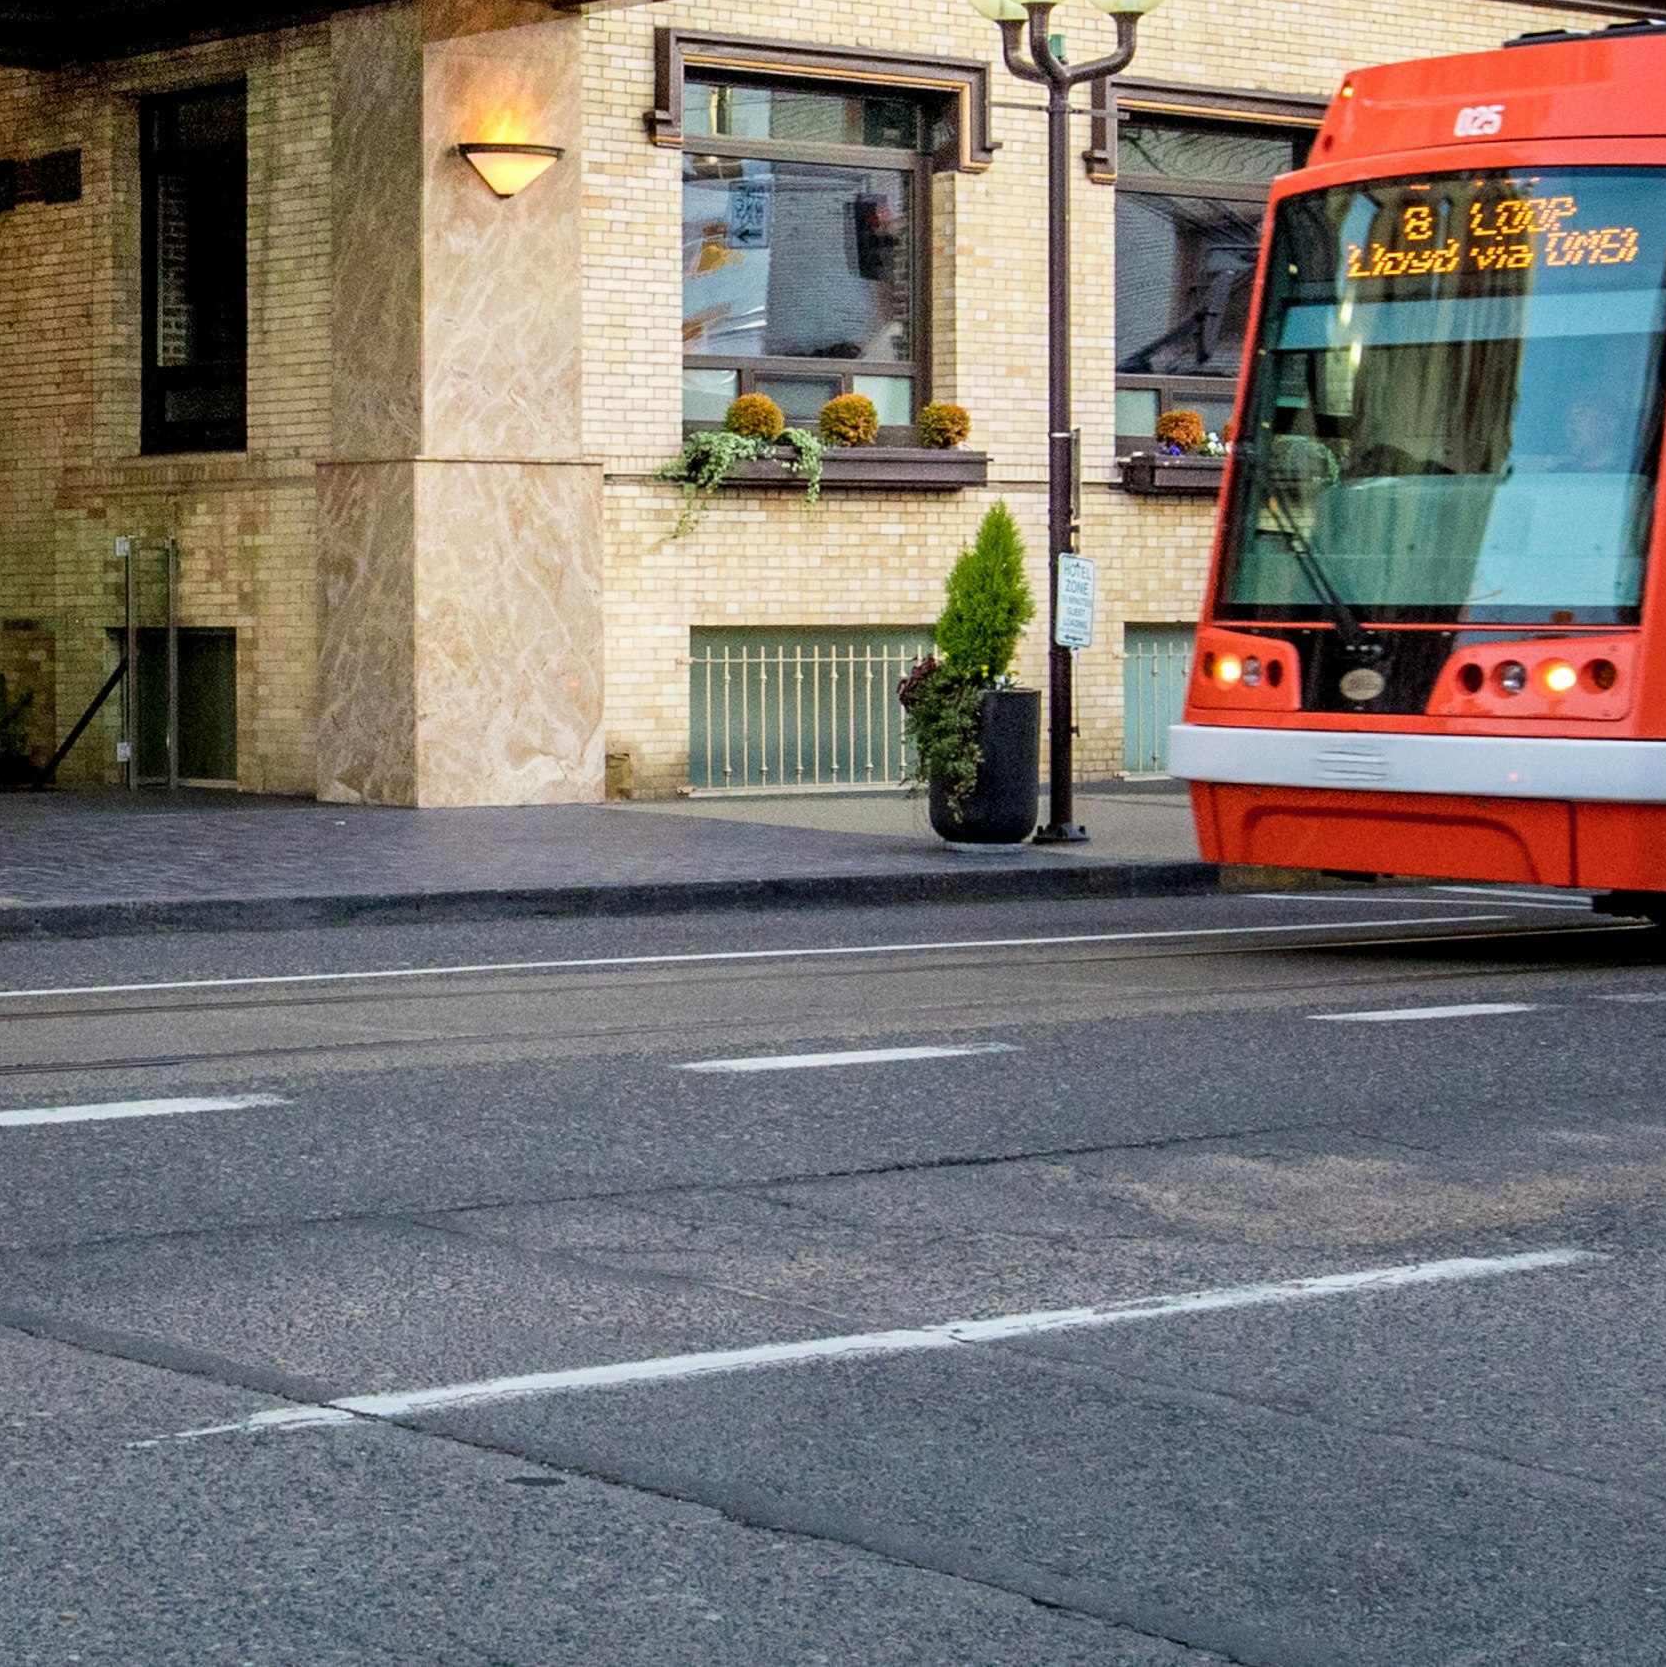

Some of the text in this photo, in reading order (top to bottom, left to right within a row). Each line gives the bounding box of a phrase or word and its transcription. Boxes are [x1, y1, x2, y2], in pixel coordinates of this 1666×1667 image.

[1469, 196, 1578, 236] LOOP
[1347, 238, 1461, 278] Lloyd
[1469, 235, 1535, 270] via
[1063, 562, 1092, 580] HOTEL
[1065, 579, 1089, 596] ZONE
